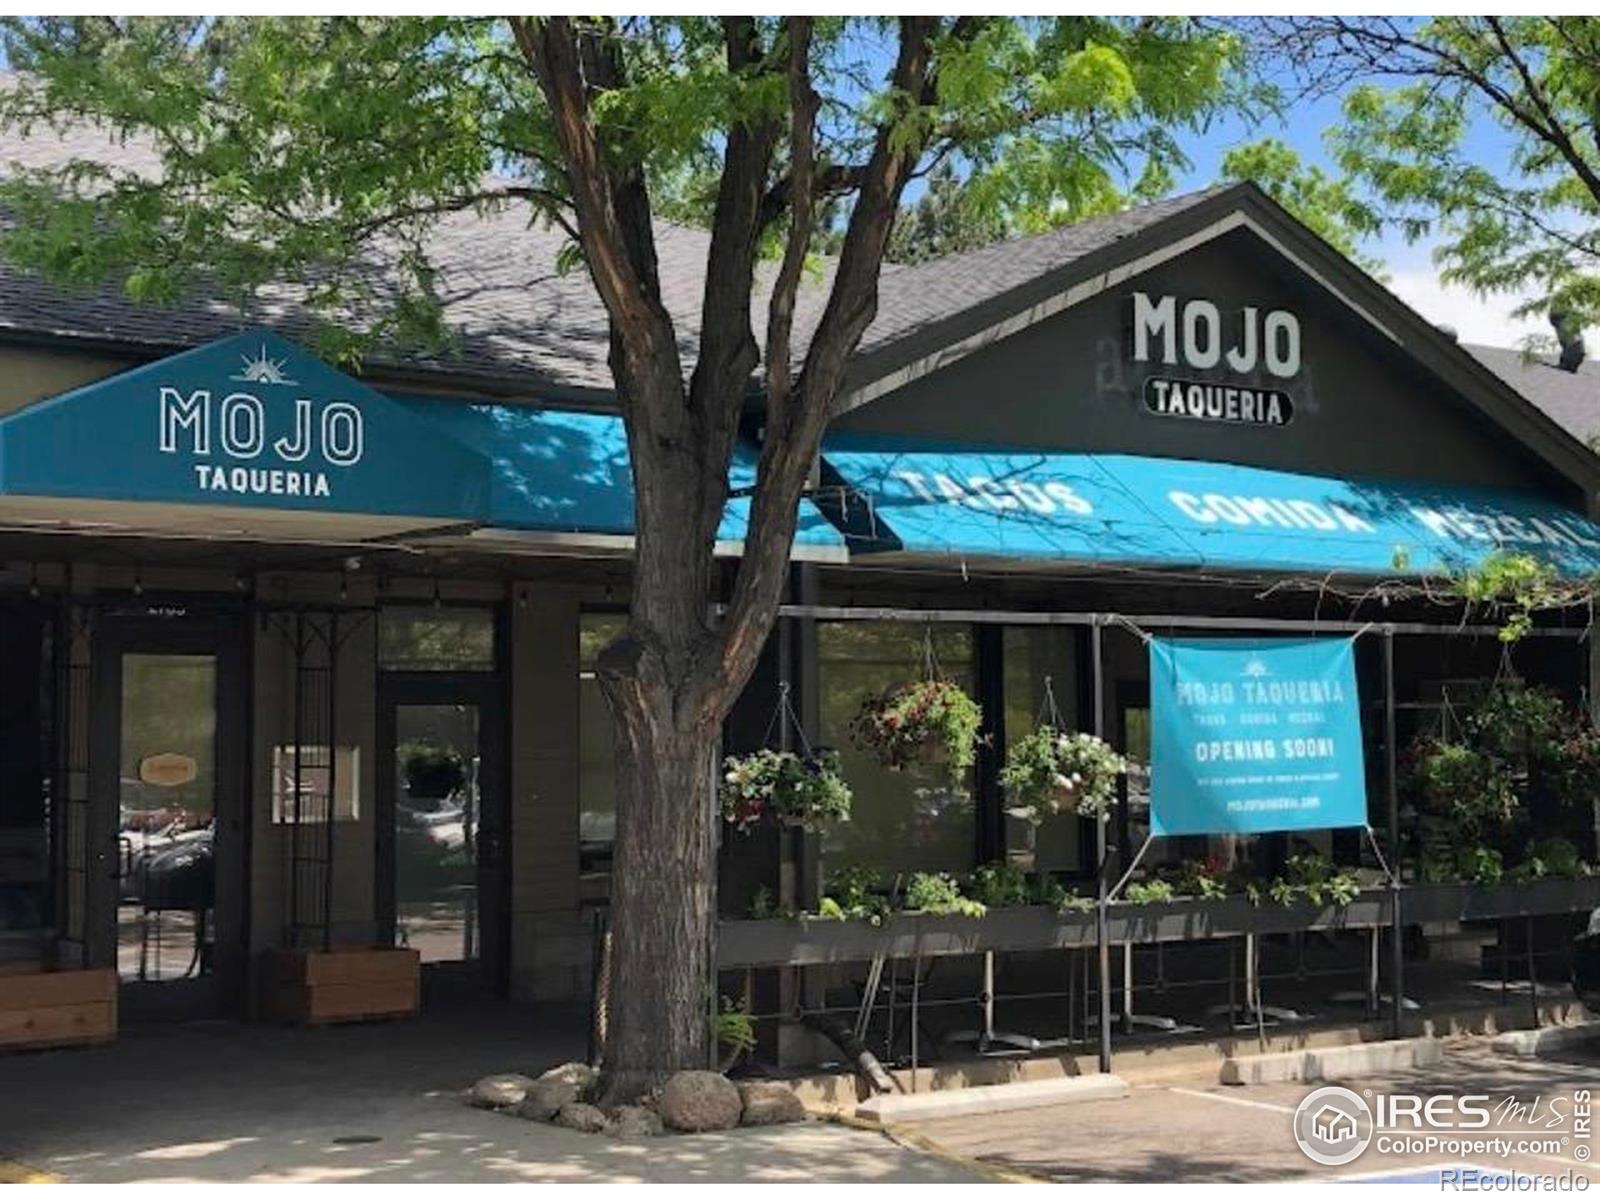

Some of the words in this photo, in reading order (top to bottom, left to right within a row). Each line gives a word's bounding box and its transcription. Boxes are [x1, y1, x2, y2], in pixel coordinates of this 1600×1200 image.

[1133, 292, 1301, 378] MOJO
[1152, 380, 1284, 424] TAQUERIA
[159, 387, 363, 466] MOJO
[194, 465, 331, 496] TAQUERIA
[898, 470, 1093, 515] TACOS
[1168, 491, 1377, 534] COMIDA
[1408, 506, 1600, 548] MEZCAL
[1177, 682, 1235, 705] MOJO
[1241, 680, 1345, 705] TAQUERIA
[1195, 740, 1276, 762] OPENING
[1282, 737, 1335, 759] SOON!
